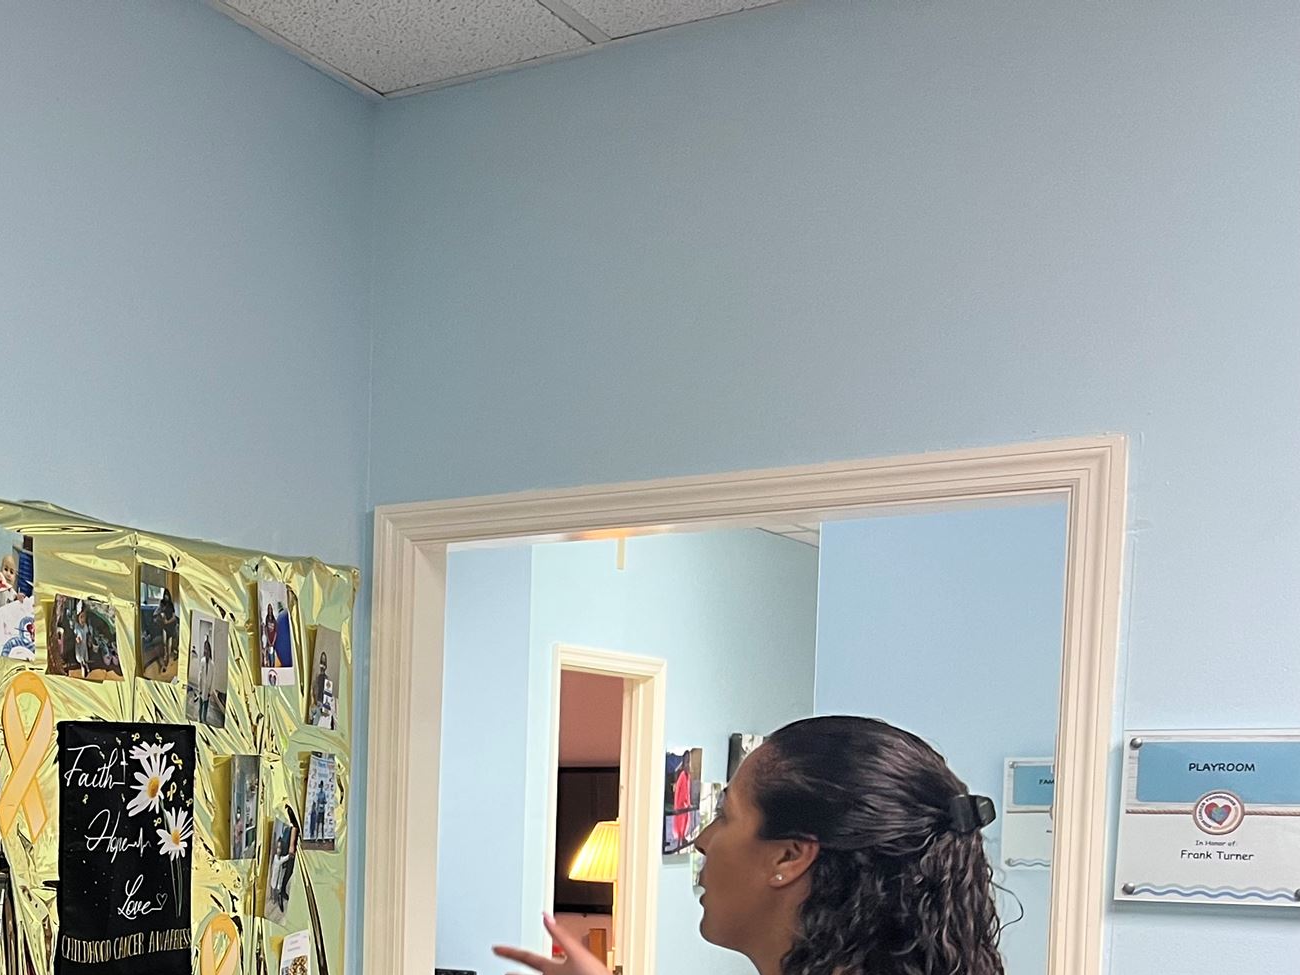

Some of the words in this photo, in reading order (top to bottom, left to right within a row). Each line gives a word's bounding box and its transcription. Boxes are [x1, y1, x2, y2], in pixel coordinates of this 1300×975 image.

[63, 744, 120, 788] Faith
[1188, 762, 1256, 773] PLAYROOM
[84, 809, 130, 863] Hope
[1180, 849, 1212, 860] Frank
[1217, 850, 1255, 861] Turner
[117, 874, 153, 920] Love
[61, 934, 112, 964] CHILDHOOD
[113, 931, 145, 960] CANCER
